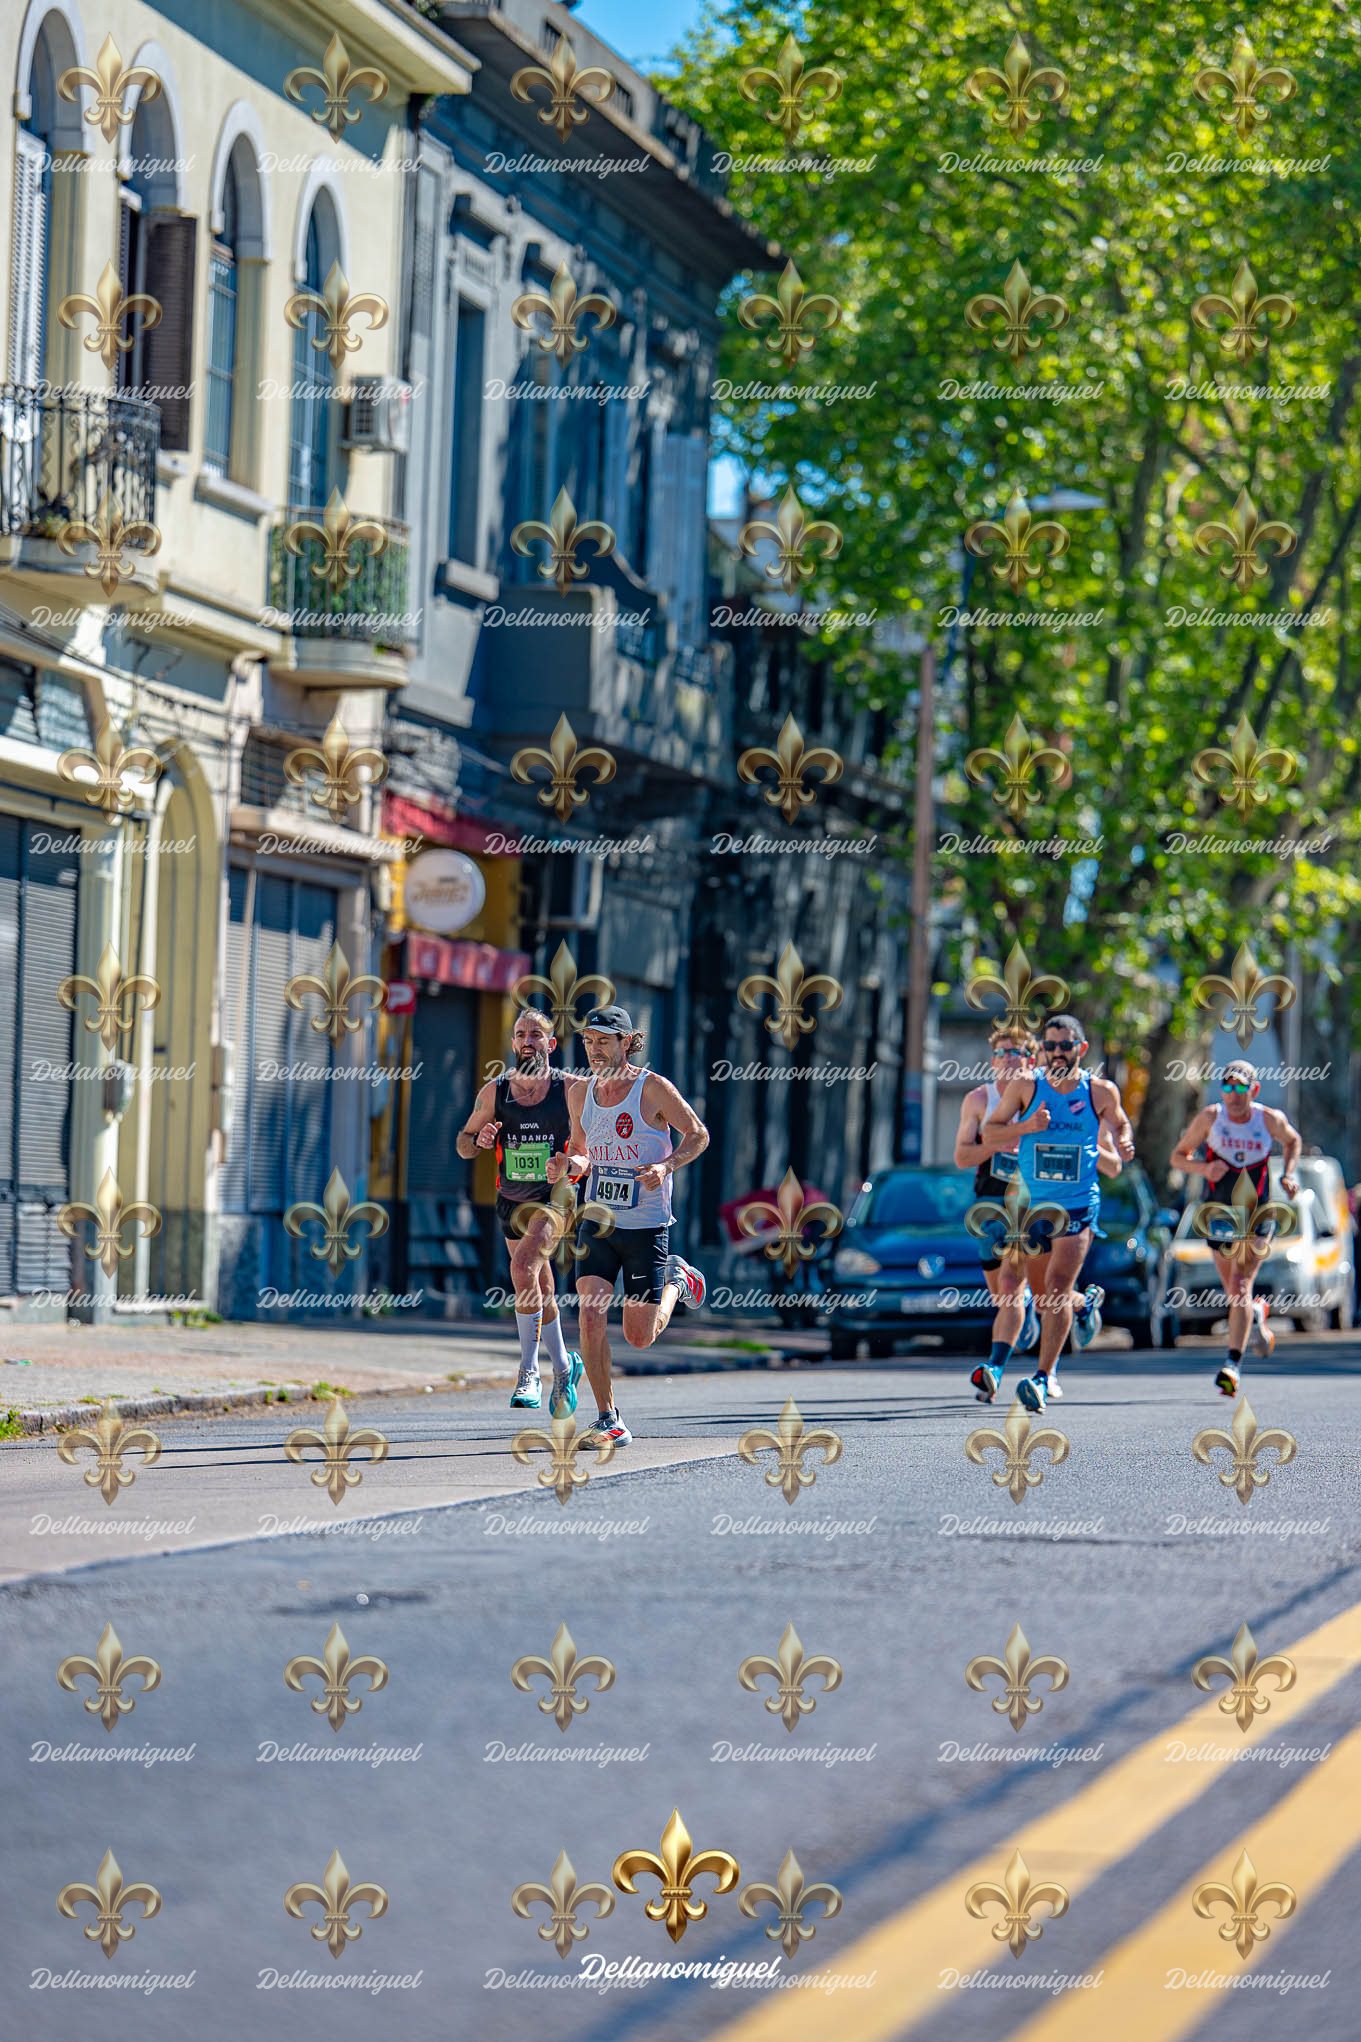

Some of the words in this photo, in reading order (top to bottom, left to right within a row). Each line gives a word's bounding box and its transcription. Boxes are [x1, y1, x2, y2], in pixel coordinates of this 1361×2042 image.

[1048, 1120, 1084, 1131] CIONAL
[507, 1133, 518, 1141] LA
[521, 1133, 555, 1141] BANDA
[589, 1144, 640, 1161] MILAN
[514, 1156, 540, 1169] 1031
[597, 1181, 630, 1202] 4974
